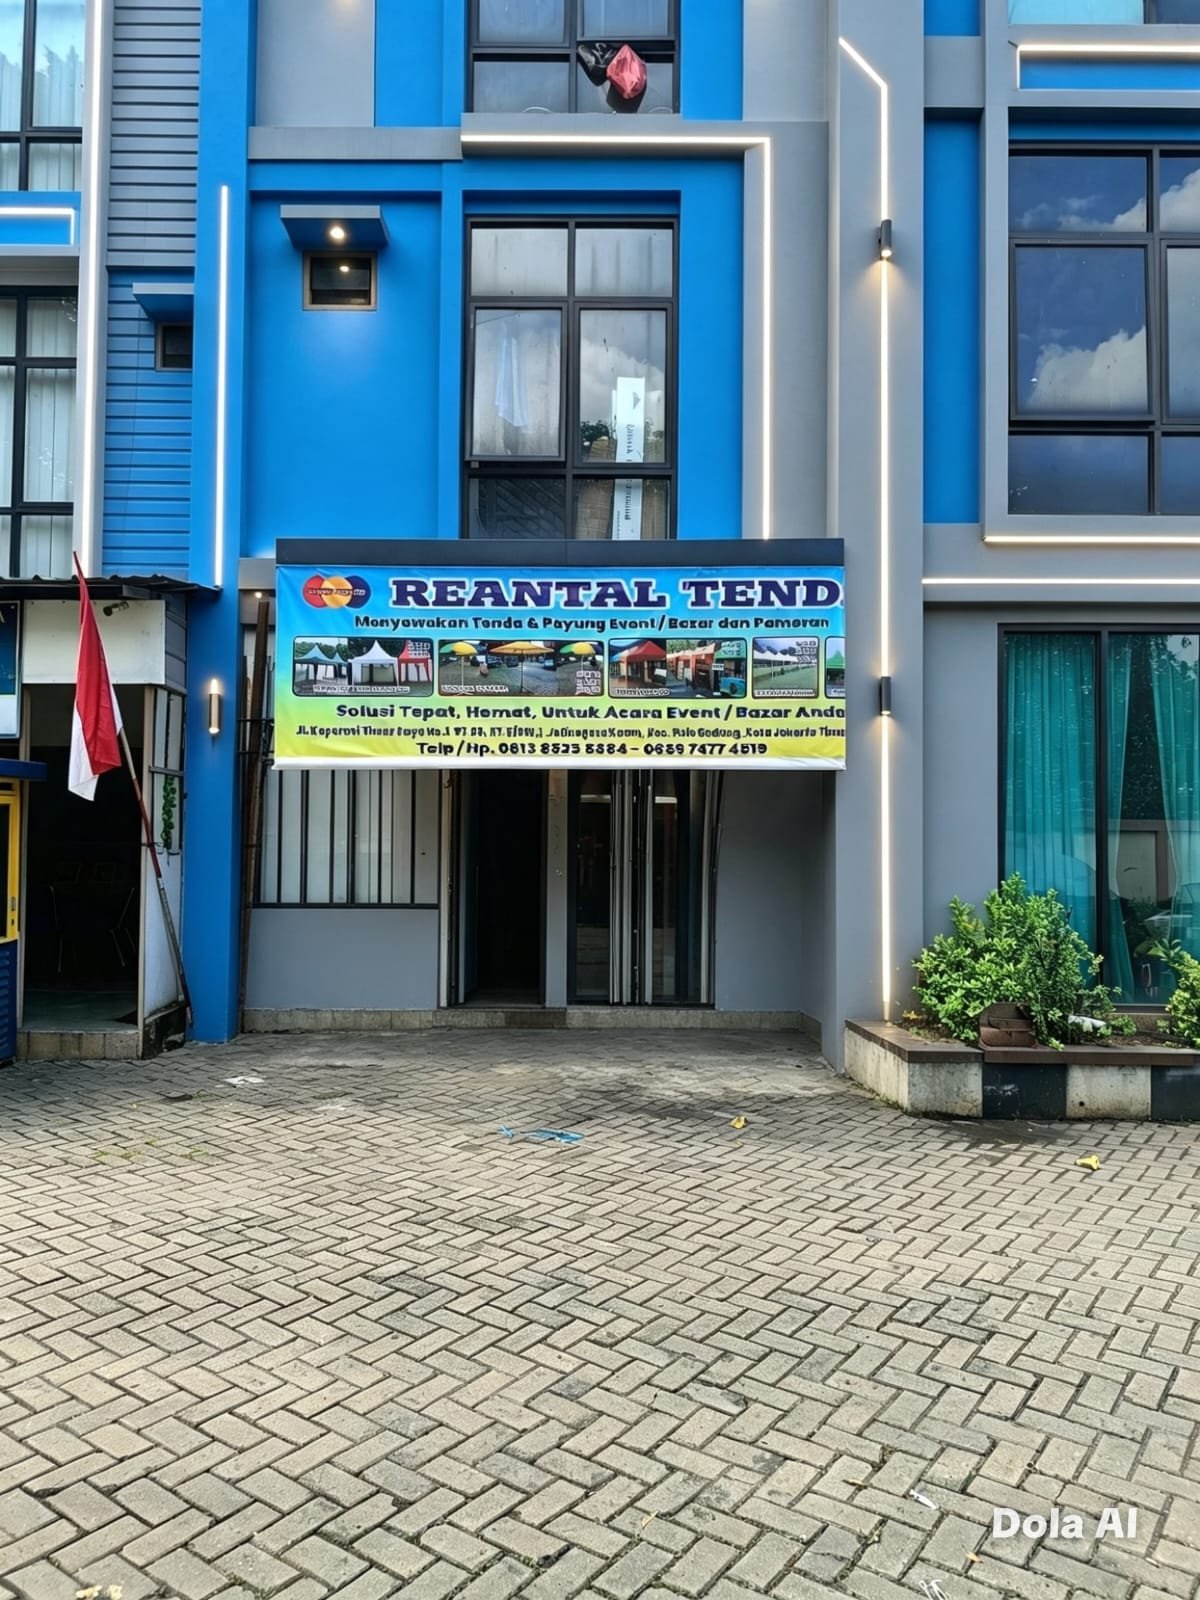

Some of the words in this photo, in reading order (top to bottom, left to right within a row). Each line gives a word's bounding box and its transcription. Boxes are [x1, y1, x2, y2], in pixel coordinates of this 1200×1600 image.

[392, 580, 667, 608] REANTAL
[682, 579, 844, 607] TEND
[527, 617, 539, 629] &
[336, 704, 395, 718] Solusi
